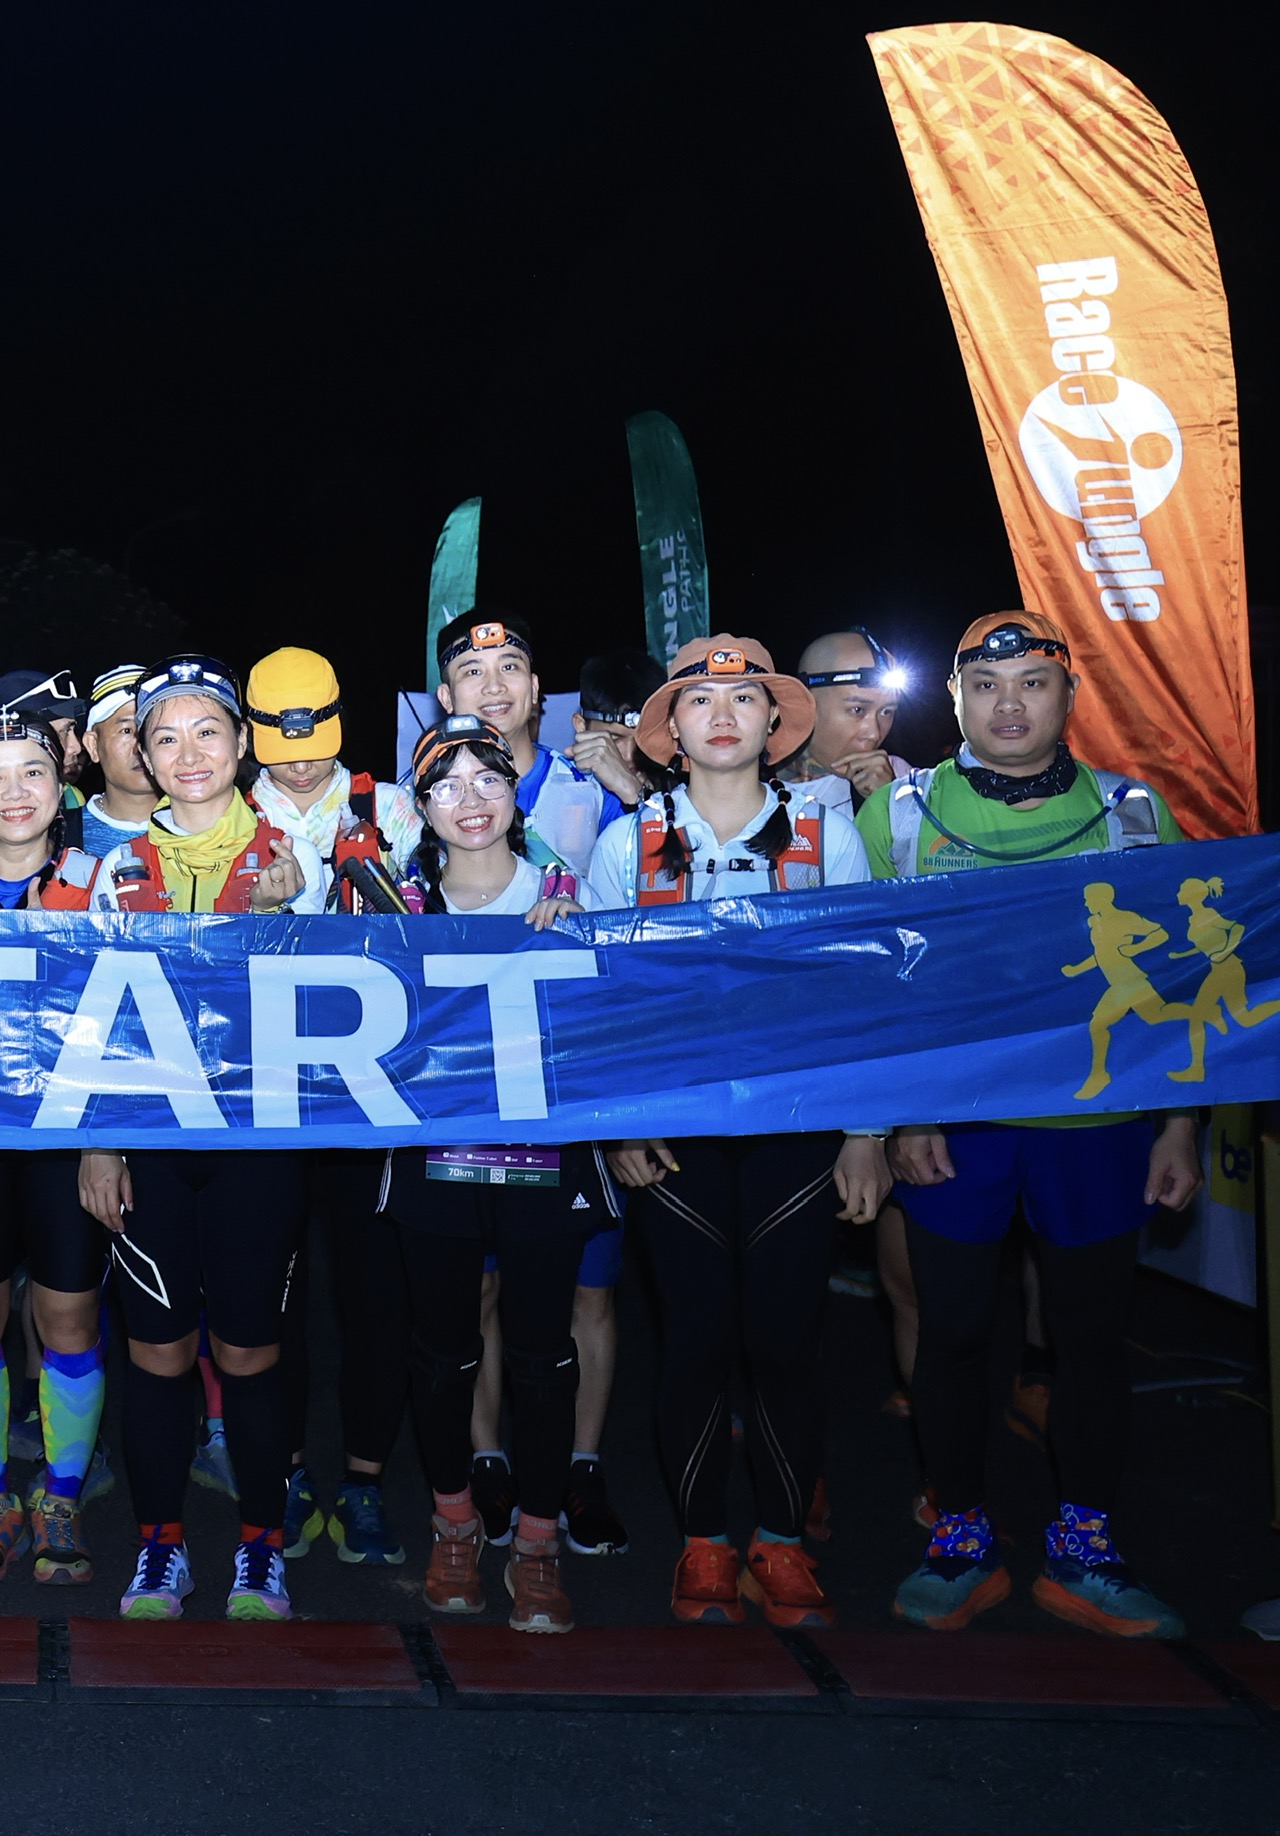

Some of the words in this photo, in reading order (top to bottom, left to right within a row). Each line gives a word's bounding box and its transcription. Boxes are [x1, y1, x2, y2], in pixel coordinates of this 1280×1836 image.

[1036, 256, 1119, 405] Race
[660, 535, 679, 669] NGLE
[448, 1167, 474, 1178] 70km
